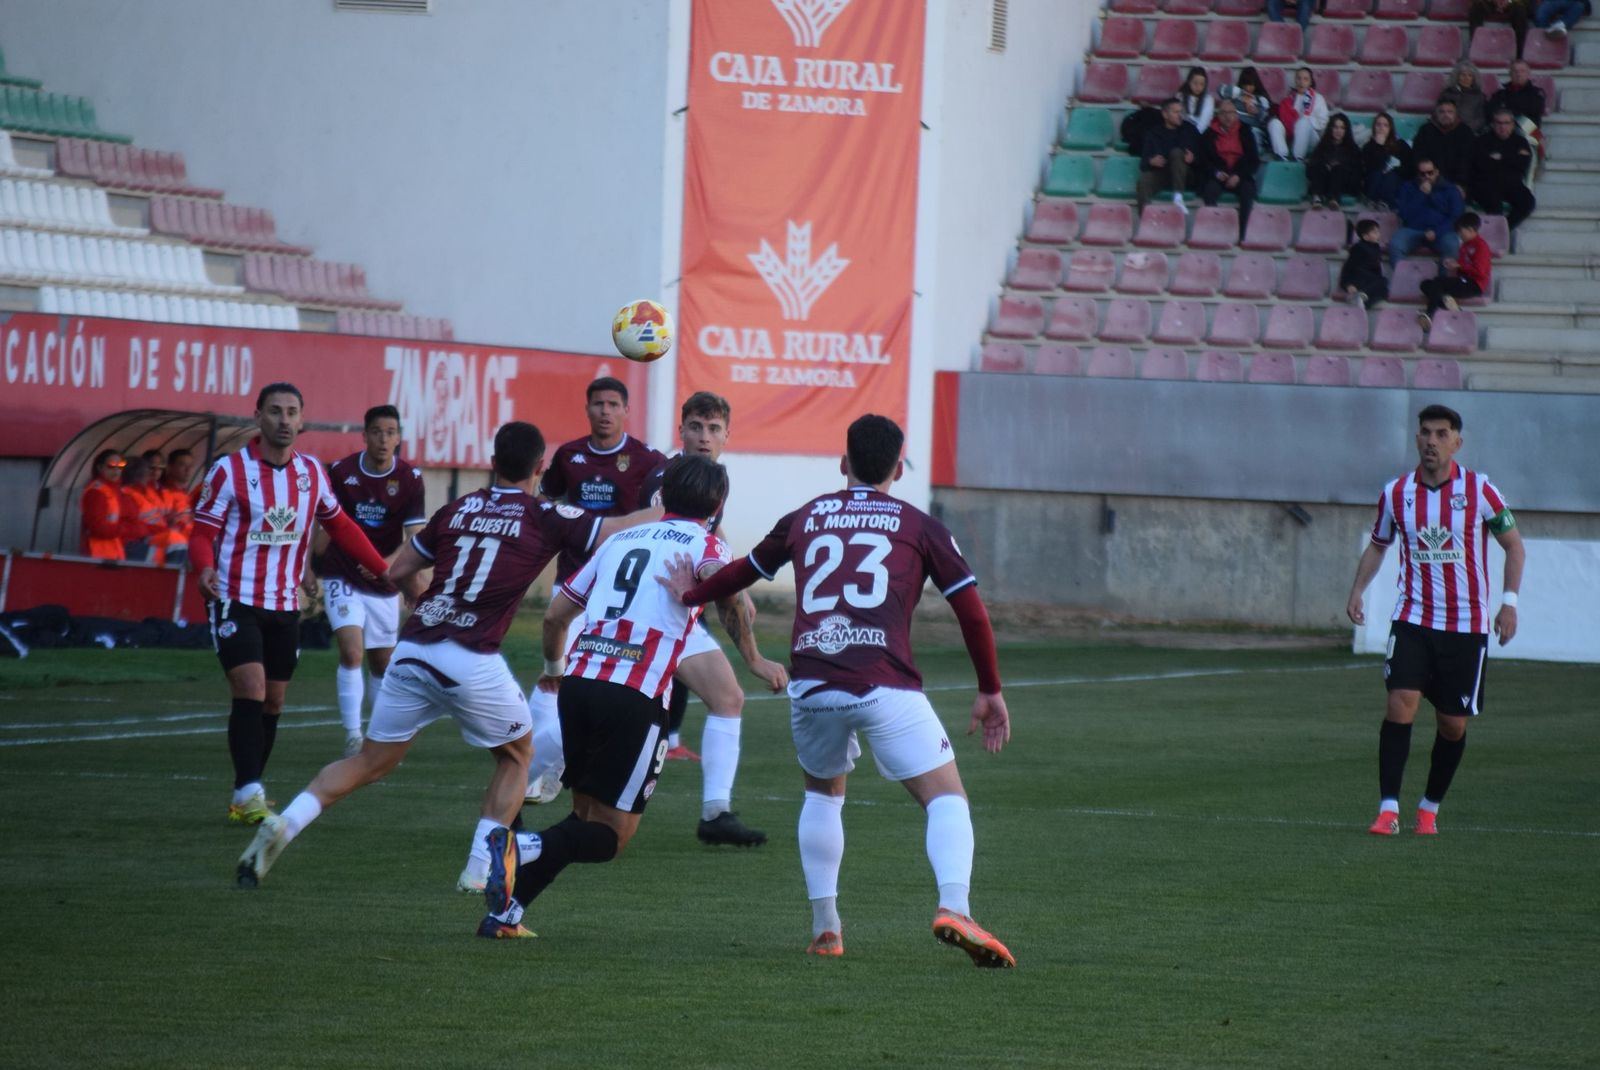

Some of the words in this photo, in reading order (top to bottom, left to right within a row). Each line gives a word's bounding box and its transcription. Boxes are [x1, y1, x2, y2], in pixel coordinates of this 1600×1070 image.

[709, 52, 787, 88] CAJA
[795, 58, 903, 94] RURAL
[741, 92, 772, 111] DE
[778, 94, 867, 117] ZAMORA
[699, 325, 775, 360] CAJA
[784, 331, 891, 365] RURAL
[128, 337, 160, 390] DE
[173, 340, 253, 396] STAND
[730, 365, 759, 384] DE
[767, 367, 857, 388] ZAMORA
[581, 482, 614, 493] Estrella
[581, 491, 612, 501] Galicia
[449, 513, 466, 529] M.
[469, 517, 522, 538] CUESTA
[804, 517, 820, 534] A.
[824, 514, 901, 533] MONTORO
[442, 535, 502, 602] 11
[603, 548, 652, 620] 9
[802, 532, 893, 615] 23
[653, 739, 669, 775] 9
